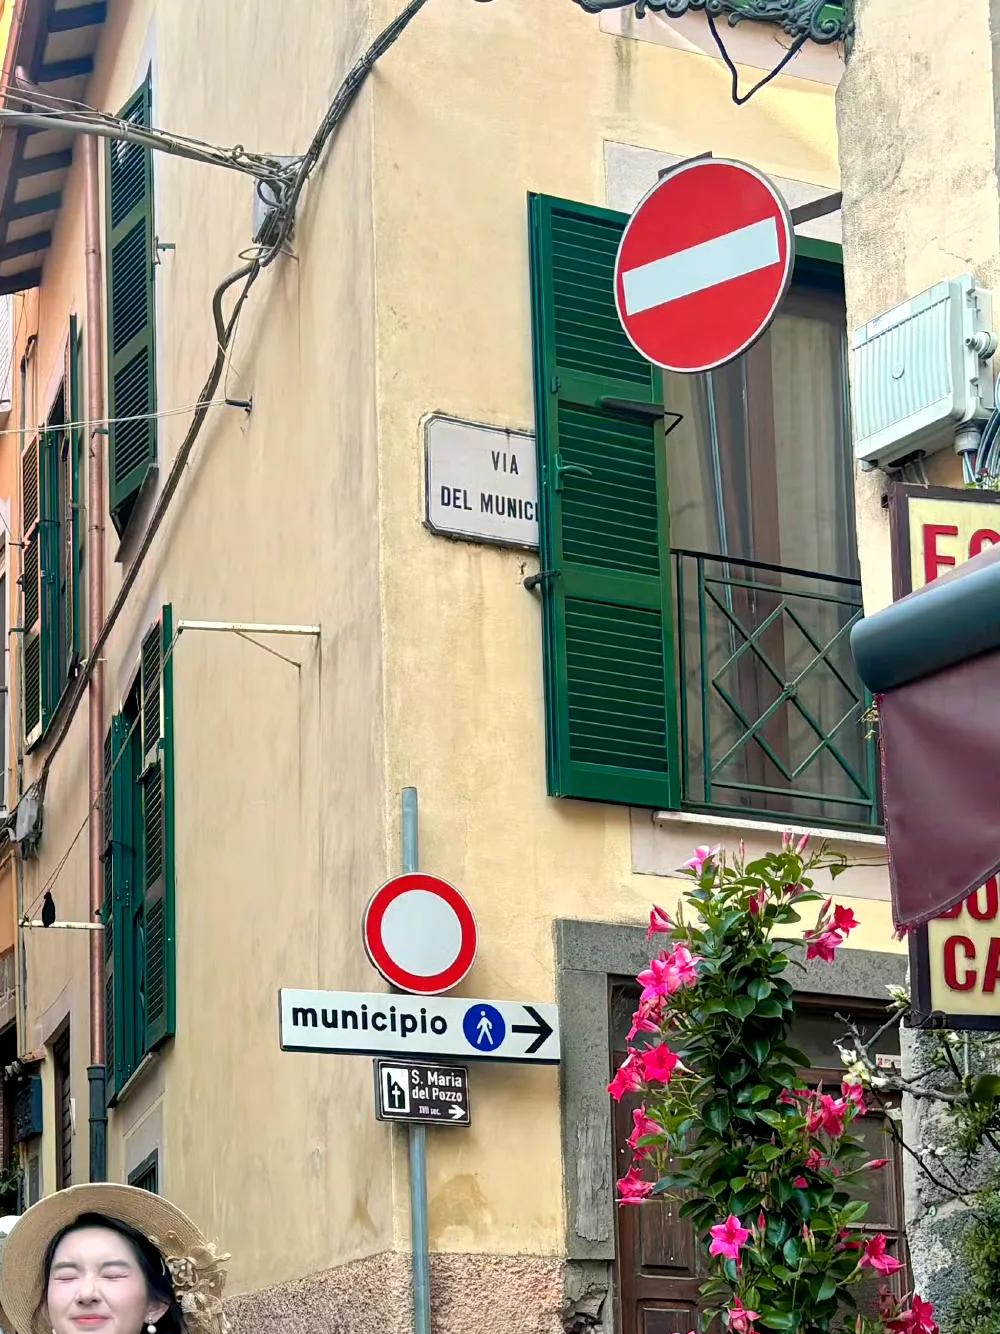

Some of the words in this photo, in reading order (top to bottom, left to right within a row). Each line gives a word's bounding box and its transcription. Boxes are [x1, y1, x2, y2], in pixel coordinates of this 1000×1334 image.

[491, 450, 519, 475] VIA
[440, 486, 473, 511] DEL
[292, 1004, 448, 1038] municipio
[411, 1069, 424, 1085] S.
[427, 1070, 462, 1088] Maria
[412, 1086, 430, 1100] del
[432, 1087, 463, 1102] Pozzo
